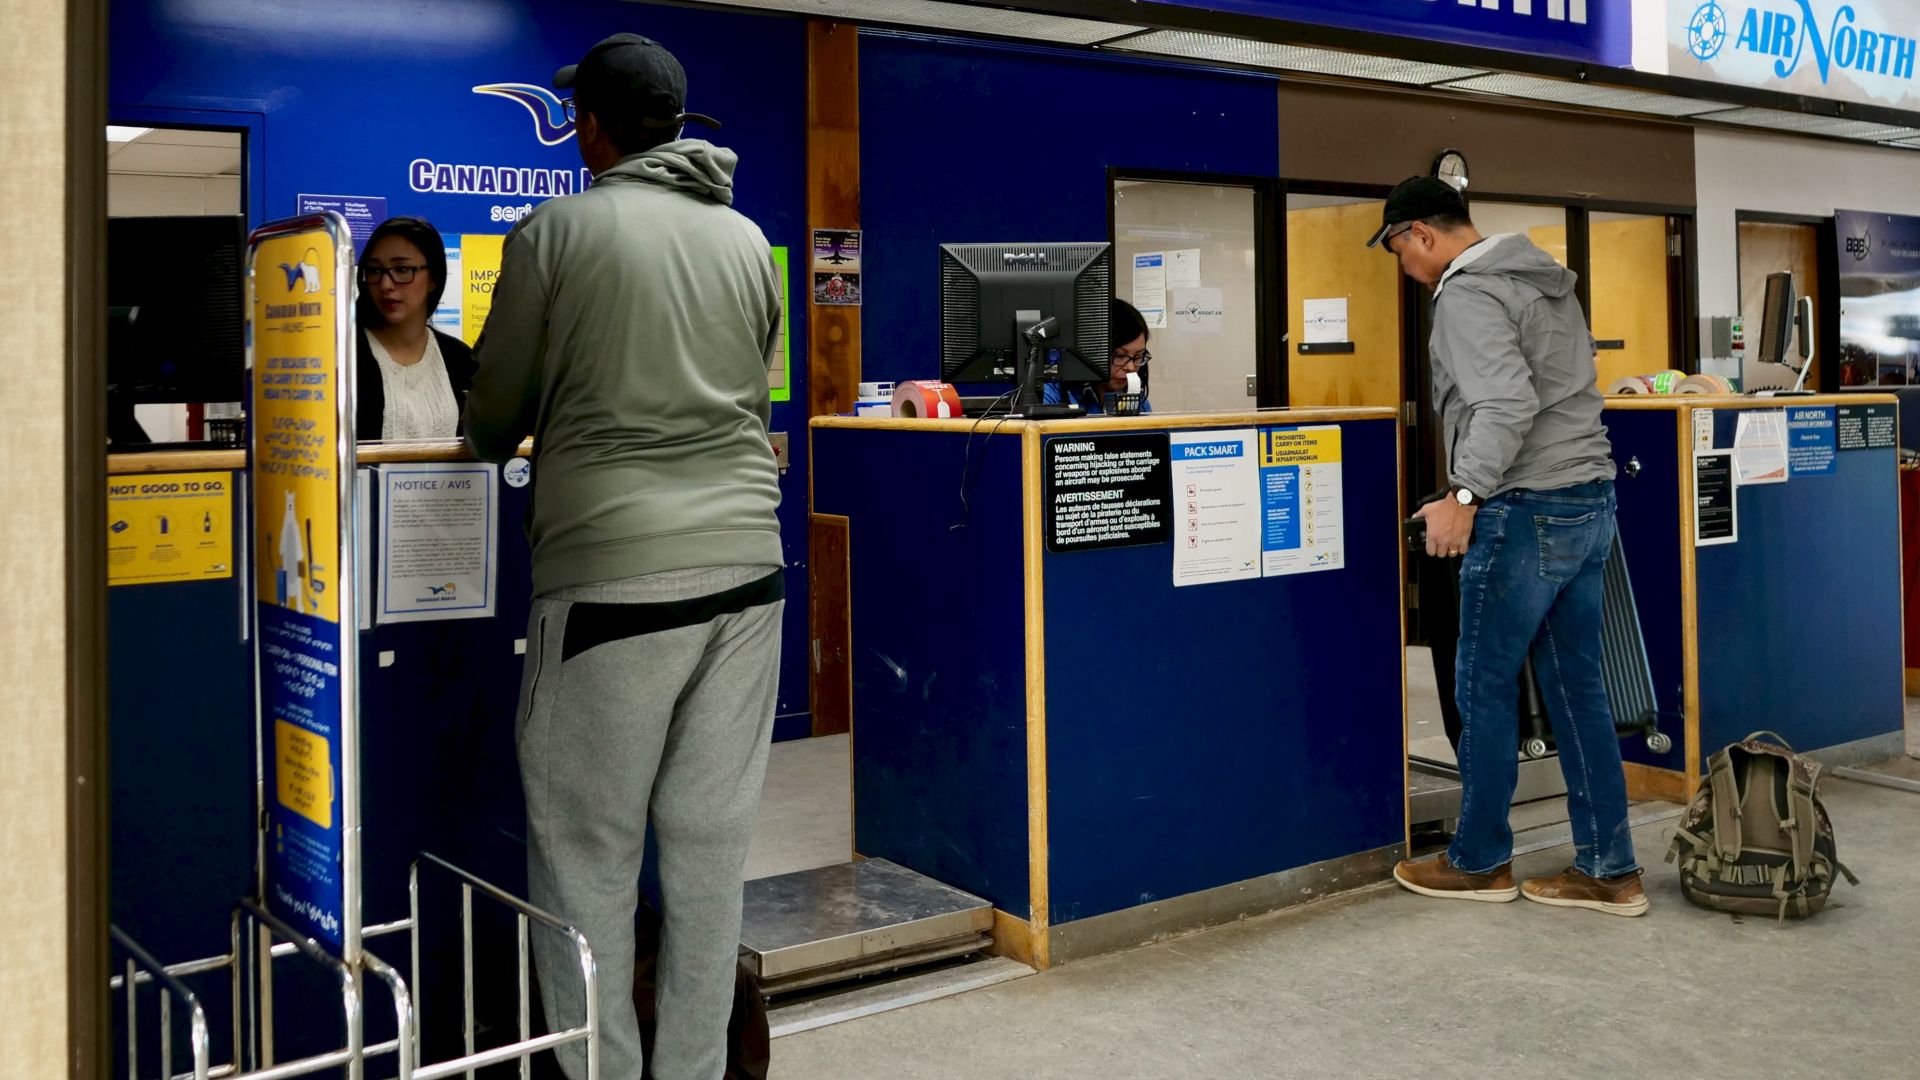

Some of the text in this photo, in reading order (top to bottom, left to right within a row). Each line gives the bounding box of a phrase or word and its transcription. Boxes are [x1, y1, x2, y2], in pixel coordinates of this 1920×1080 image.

[1735, 0, 1917, 84] AIR NORTH
[409, 159, 573, 197] CANADIAN
[490, 203, 534, 222] seri
[1004, 253, 1049, 265] DELL
[471, 270, 501, 280] IMPO
[1807, 411, 1826, 419] NORTH
[1055, 442, 1095, 453] WARNING
[1185, 445, 1238, 457] PACK SMART
[1081, 453, 1103, 461] making
[1105, 452, 1118, 460] false
[1120, 451, 1152, 459] statements
[1055, 463, 1088, 471] concerning
[1090, 461, 1117, 469] hijacking
[1063, 470, 1090, 478] weapons
[1099, 468, 1129, 477] explosives
[1111, 474, 1145, 483] prosecuted.
[141, 484, 179, 493] GOOD
[183, 482, 200, 491] TO
[394, 481, 437, 491] NOTICE
[447, 480, 471, 489] AVIS
[1055, 490, 1124, 503] AVERTISSEMENT
[1069, 504, 1091, 512] auteurs
[1101, 501, 1124, 509] fausses
[1125, 499, 1160, 508] déclarations
[1065, 512, 1080, 520] sujet
[1097, 509, 1121, 518] piraterie
[1056, 521, 1083, 529] transport
[1119, 515, 1150, 523] d'explosifs
[1057, 528, 1070, 536] bord
[1072, 527, 1085, 535] d'un
[1087, 525, 1109, 533] aéronef
[1124, 521, 1160, 530] susceptibles
[1066, 534, 1097, 544] poursuites
[1098, 532, 1130, 541] judiciaires.
